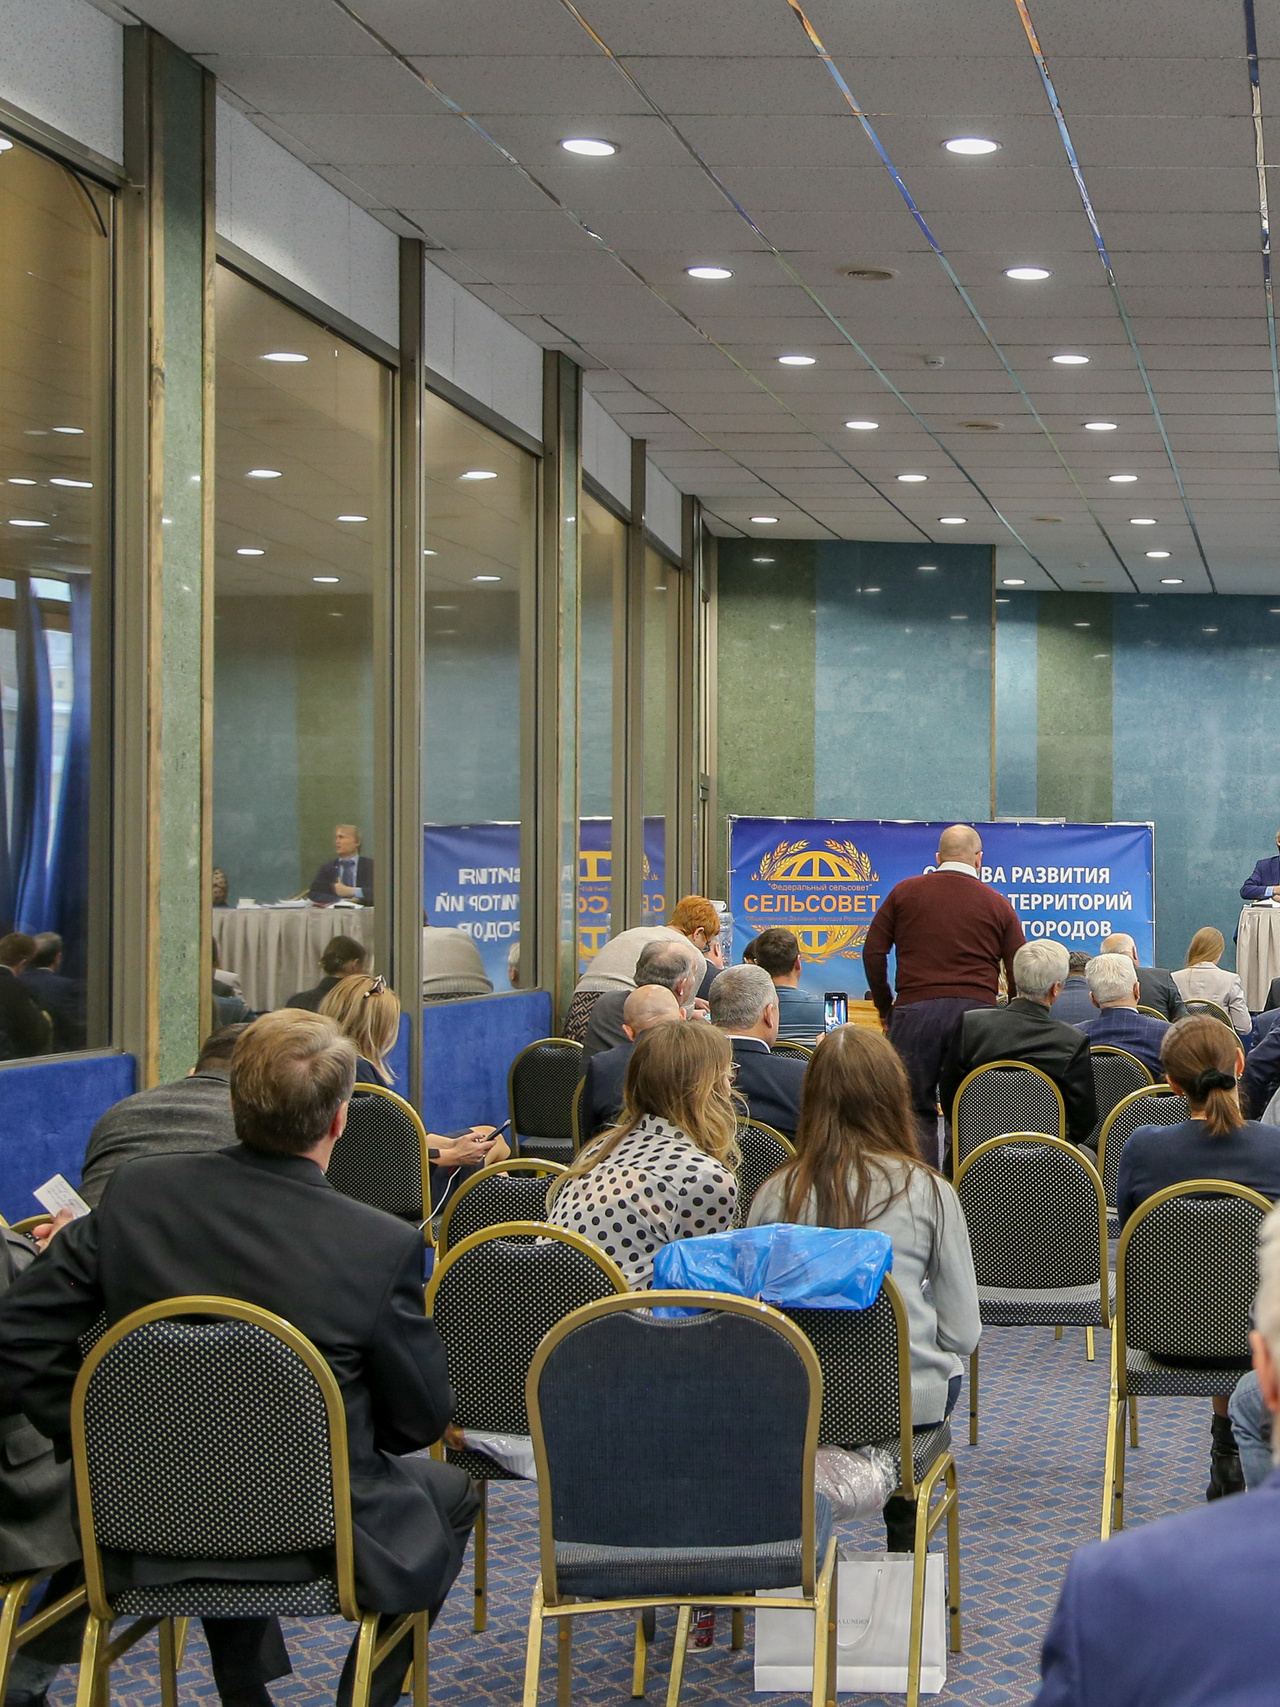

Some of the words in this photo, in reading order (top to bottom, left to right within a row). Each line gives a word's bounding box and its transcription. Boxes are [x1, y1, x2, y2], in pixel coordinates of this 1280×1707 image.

[1011, 866, 1110, 884] РАЗВИТИЯ
[743, 894, 881, 913] СЕЛЬСОВЕТ
[1007, 891, 1132, 910] ТЕРРИТОРИЙ
[1021, 920, 1112, 940] ГОРОДОВ
